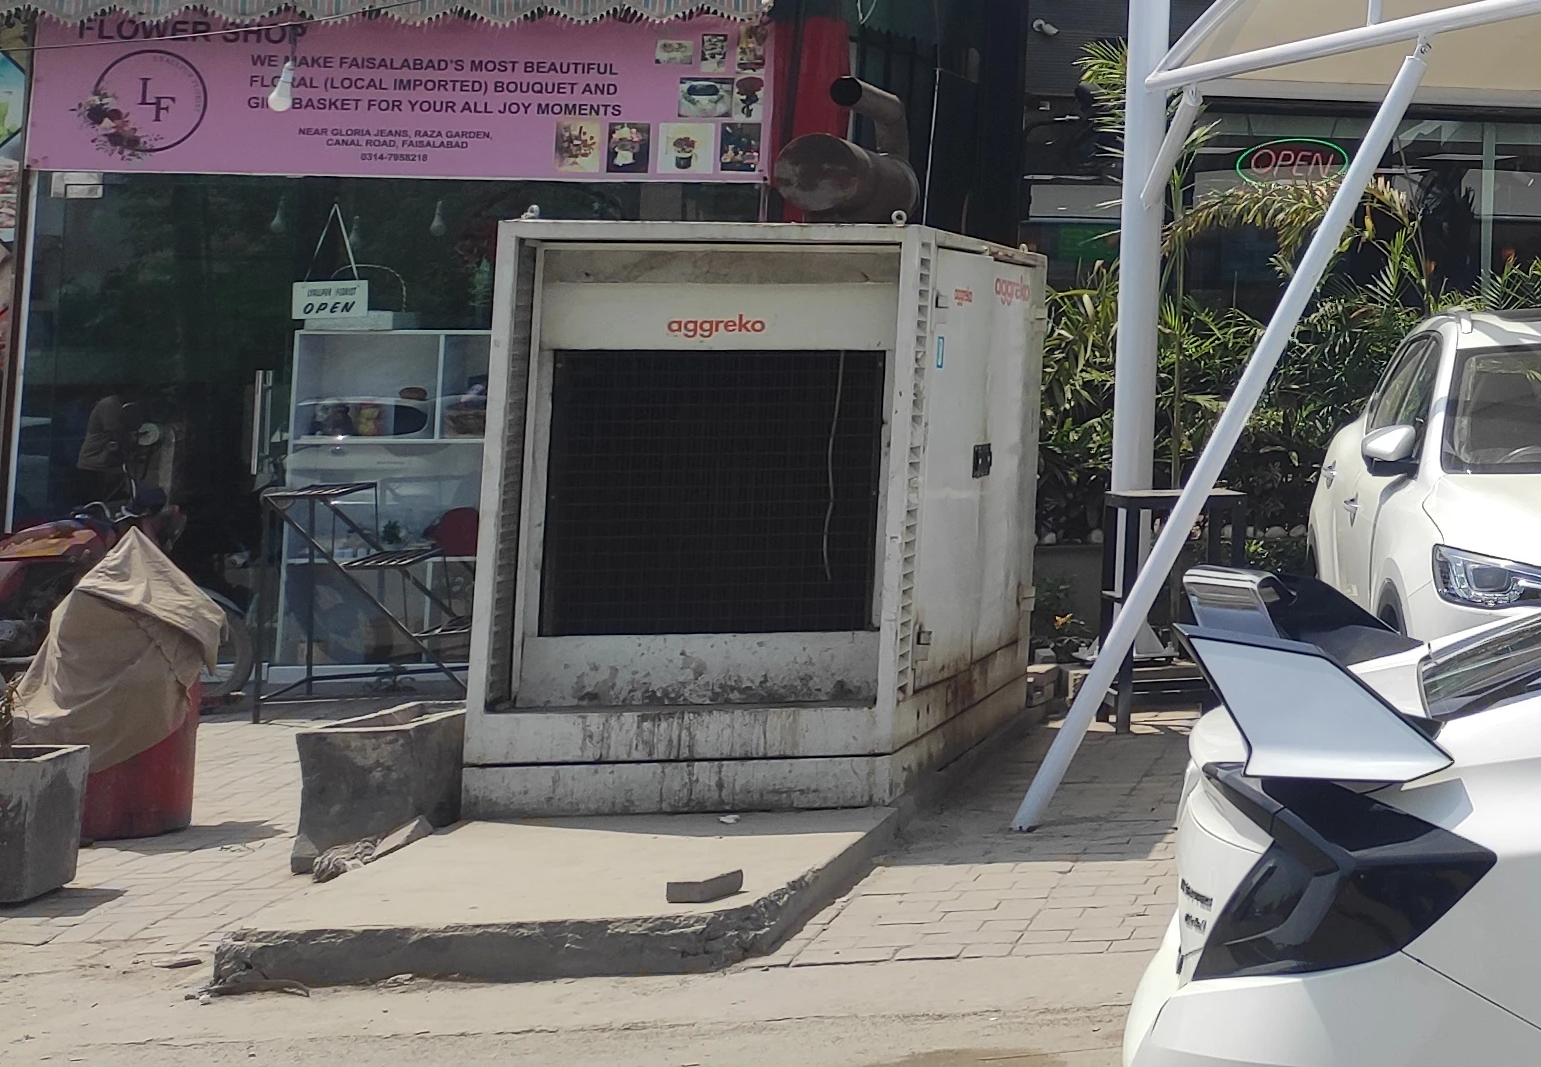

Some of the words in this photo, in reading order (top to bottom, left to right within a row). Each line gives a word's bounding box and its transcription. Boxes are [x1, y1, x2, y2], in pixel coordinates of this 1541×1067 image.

[79, 19, 212, 42] FLOWER
[222, 21, 307, 45] SHOP
[251, 54, 279, 67] WE
[339, 57, 465, 72] FAISALABAD'S
[470, 59, 519, 73] MOST
[523, 61, 619, 75] BEAUTIFUL
[323, 76, 389, 92] (LOCAL
[393, 78, 488, 96] IMPORTED)
[493, 81, 578, 96] BOUQUET
[581, 83, 618, 96] AND
[291, 97, 362, 111] BASKET
[367, 99, 403, 112] FOR
[408, 100, 457, 114] YOUR
[460, 101, 493, 114] ALL
[498, 102, 533, 115] JOY
[536, 102, 622, 117] MOMENTS
[298, 127, 329, 137] NEAR
[331, 128, 372, 138] GLORIA
[374, 129, 412, 139] JEANS,
[414, 129, 443, 139] RAZA
[445, 130, 493, 140] GARDEN,
[326, 138, 363, 147] CANAL
[365, 139, 399, 149] ROAD,
[401, 139, 469, 150] FAISALABAD
[1251, 148, 1335, 178] OPEN
[303, 300, 356, 315] OPEN
[667, 313, 766, 339] aggreko
